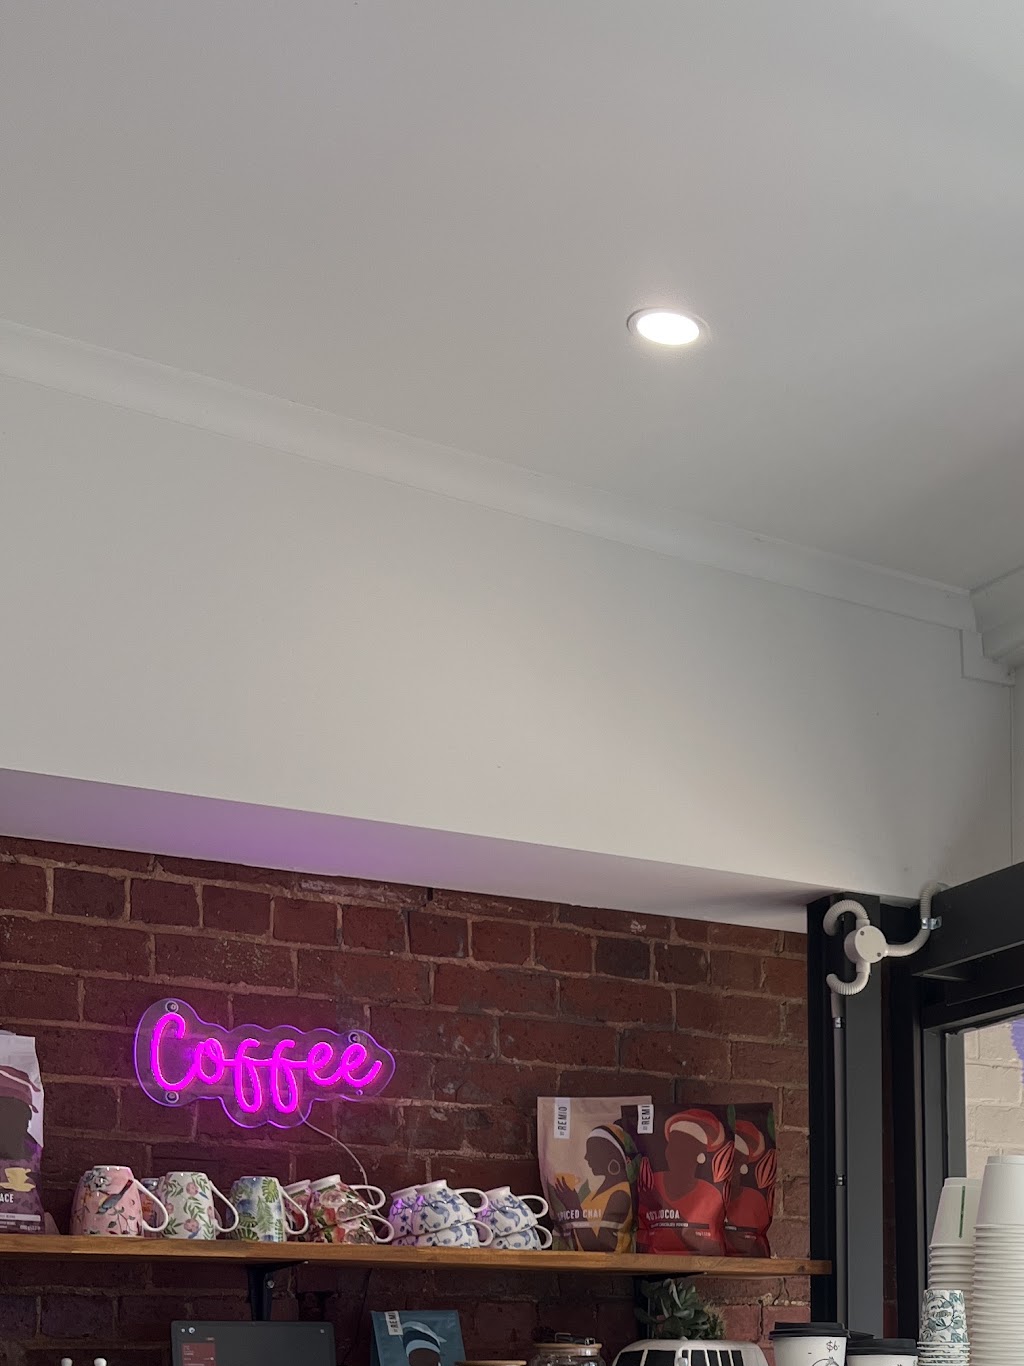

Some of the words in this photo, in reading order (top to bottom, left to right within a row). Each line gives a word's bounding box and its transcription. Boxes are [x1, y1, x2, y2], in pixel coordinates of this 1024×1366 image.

[150, 1012, 383, 1114] Coffee
[557, 1106, 568, 1131] REMIO
[558, 1209, 580, 1221] SPICED
[583, 1208, 602, 1219] CHAI
